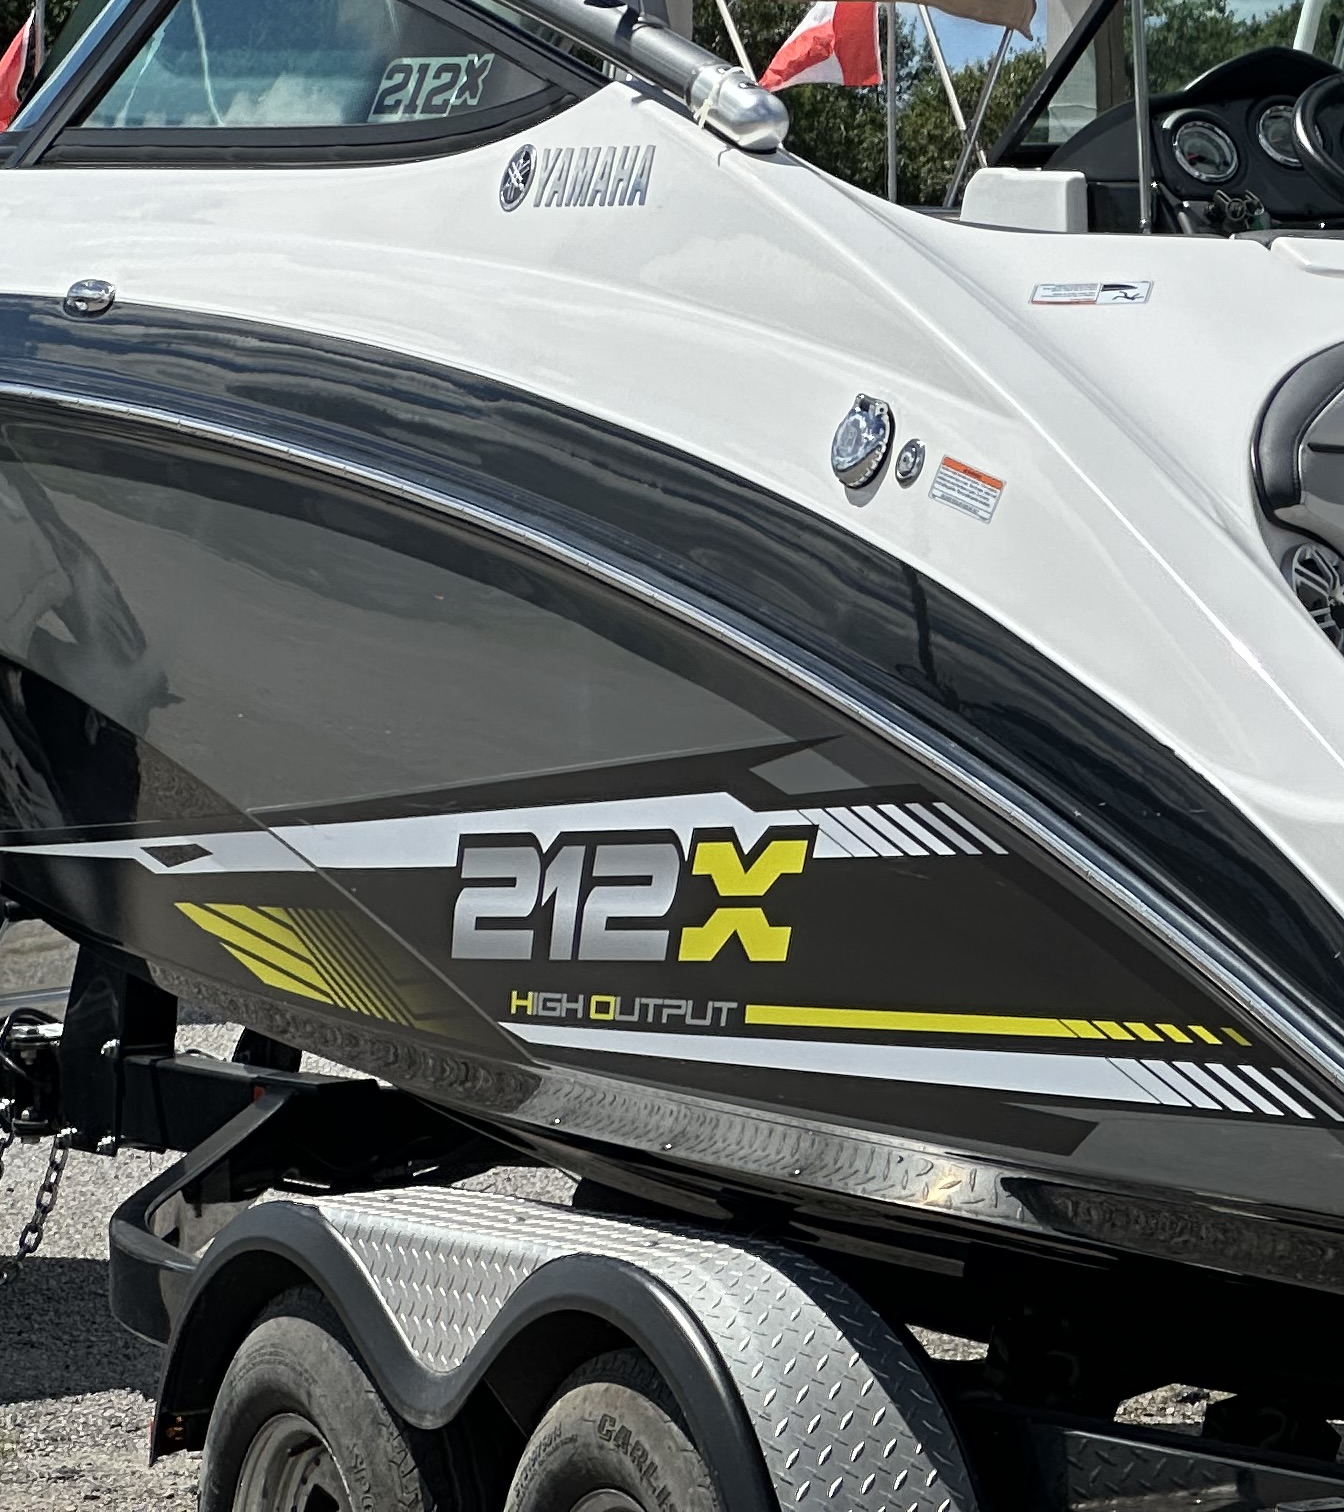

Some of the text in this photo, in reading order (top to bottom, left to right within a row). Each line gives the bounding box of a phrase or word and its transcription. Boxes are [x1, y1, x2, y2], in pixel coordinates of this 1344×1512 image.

[368, 54, 495, 123] 212X
[533, 144, 657, 208] YAMAHA
[451, 839, 809, 962] 212X
[509, 989, 738, 1027] HIGH OUTPUT
